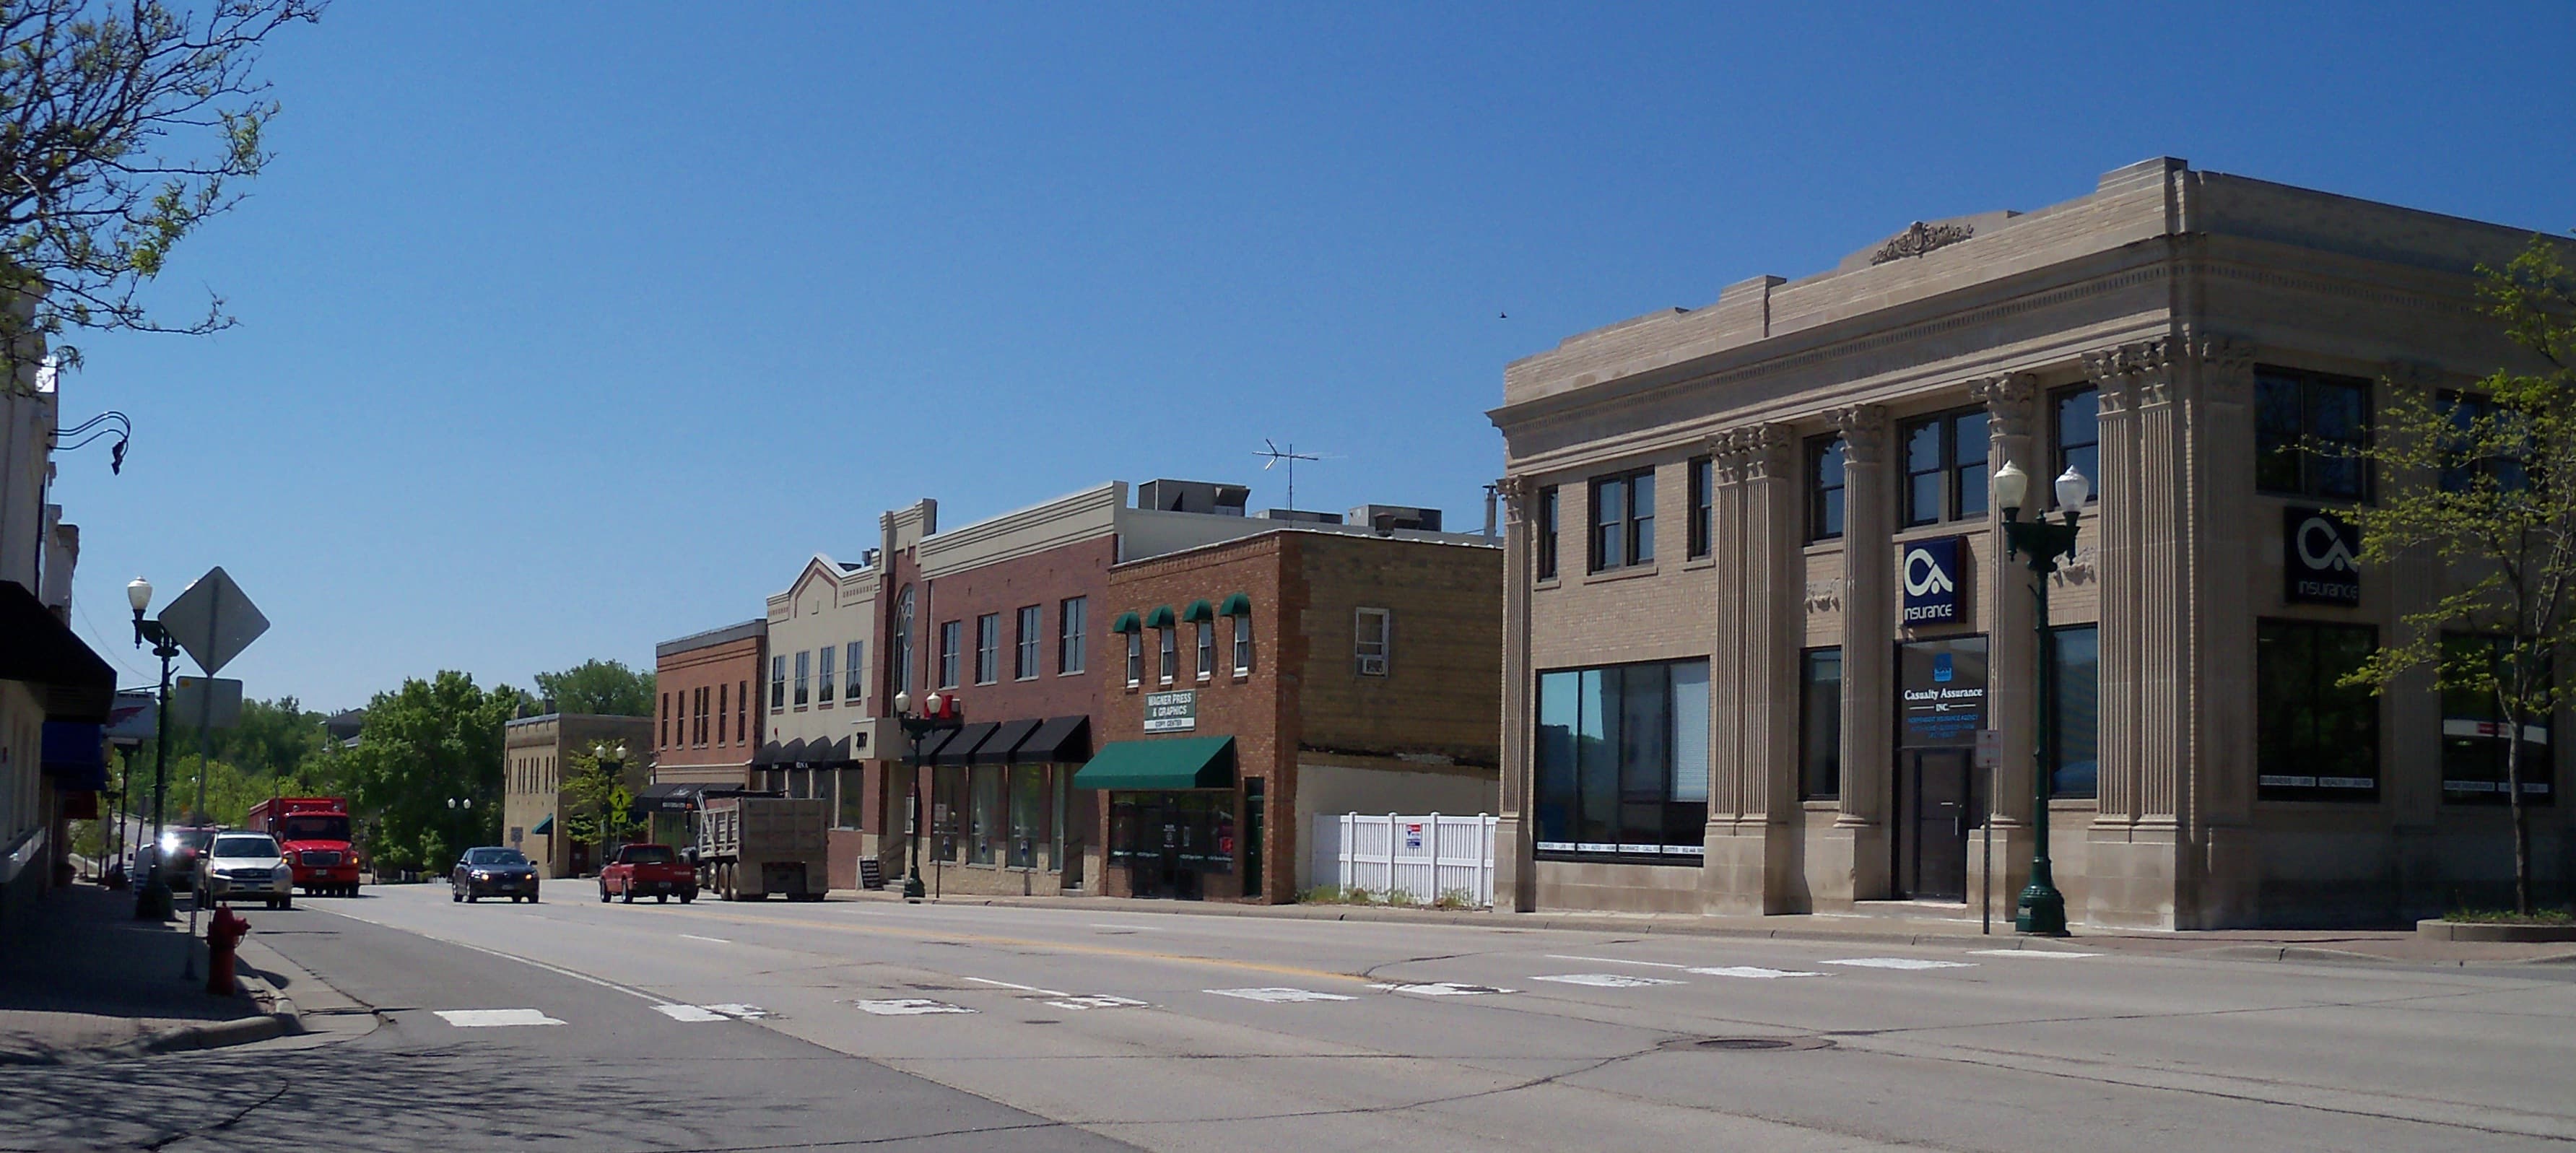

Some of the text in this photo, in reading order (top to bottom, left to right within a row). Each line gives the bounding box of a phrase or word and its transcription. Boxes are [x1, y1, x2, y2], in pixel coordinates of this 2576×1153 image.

[1148, 692, 1191, 706] WAGNER PRESS
[1904, 688, 1983, 700] Casualty Assurance
[1158, 705, 1188, 716] GRAPHICS
